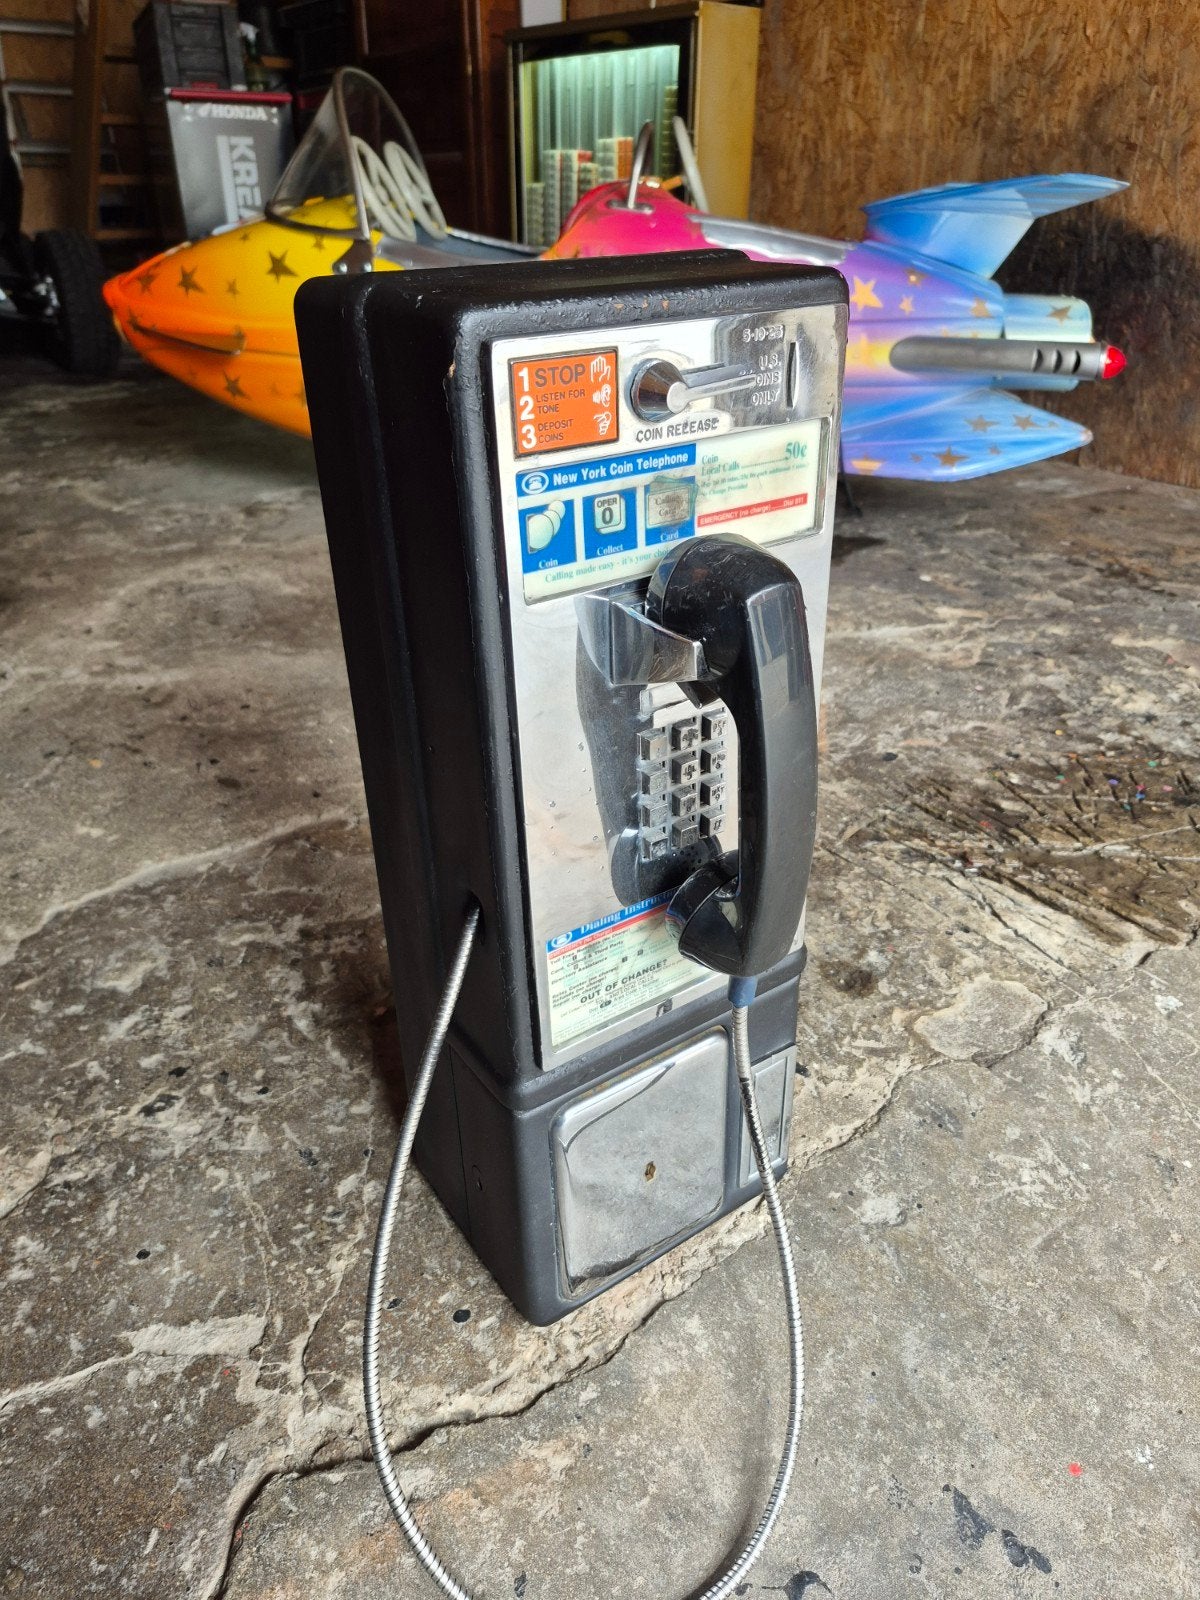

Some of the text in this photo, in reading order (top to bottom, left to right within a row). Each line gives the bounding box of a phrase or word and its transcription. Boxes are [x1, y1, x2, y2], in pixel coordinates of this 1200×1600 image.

[213, 103, 268, 121] HONDA
[759, 353, 781, 370] U.S.
[518, 366, 530, 392] 1
[534, 363, 586, 388] STOP
[754, 371, 781, 386] OINS
[536, 388, 586, 402] LISTEN FOR
[752, 388, 780, 406] ONLY
[520, 395, 535, 420] 2
[538, 404, 560, 414] TONE
[538, 418, 574, 432] DEPOSIT
[636, 417, 720, 443] COIN RELEASE
[521, 424, 538, 449] 3
[538, 432, 564, 444] COINS
[552, 452, 689, 486] New York Coin Telephone
[701, 465, 720, 476] Local
[722, 461, 740, 472] Calls
[702, 454, 719, 466] Coin
[596, 497, 618, 508] OPER
[602, 506, 614, 525] 0
[700, 512, 738, 525] EMERGENCY
[740, 510, 749, 518] (no
[750, 504, 772, 515] charge)
[660, 532, 679, 542] Card
[596, 544, 624, 558] Collect
[538, 557, 558, 570] Coin
[544, 569, 574, 584] Calling
[576, 564, 597, 577] made
[598, 560, 614, 574] easy
[622, 554, 634, 566] it's
[634, 551, 652, 565] your
[581, 911, 621, 934] Dialing
[594, 946, 608, 955] Third
[551, 970, 576, 984] Directory
[578, 956, 607, 972] Assistance
[580, 988, 601, 1004] OUT
[605, 980, 617, 992] OF
[621, 958, 667, 985] CHANGE?
